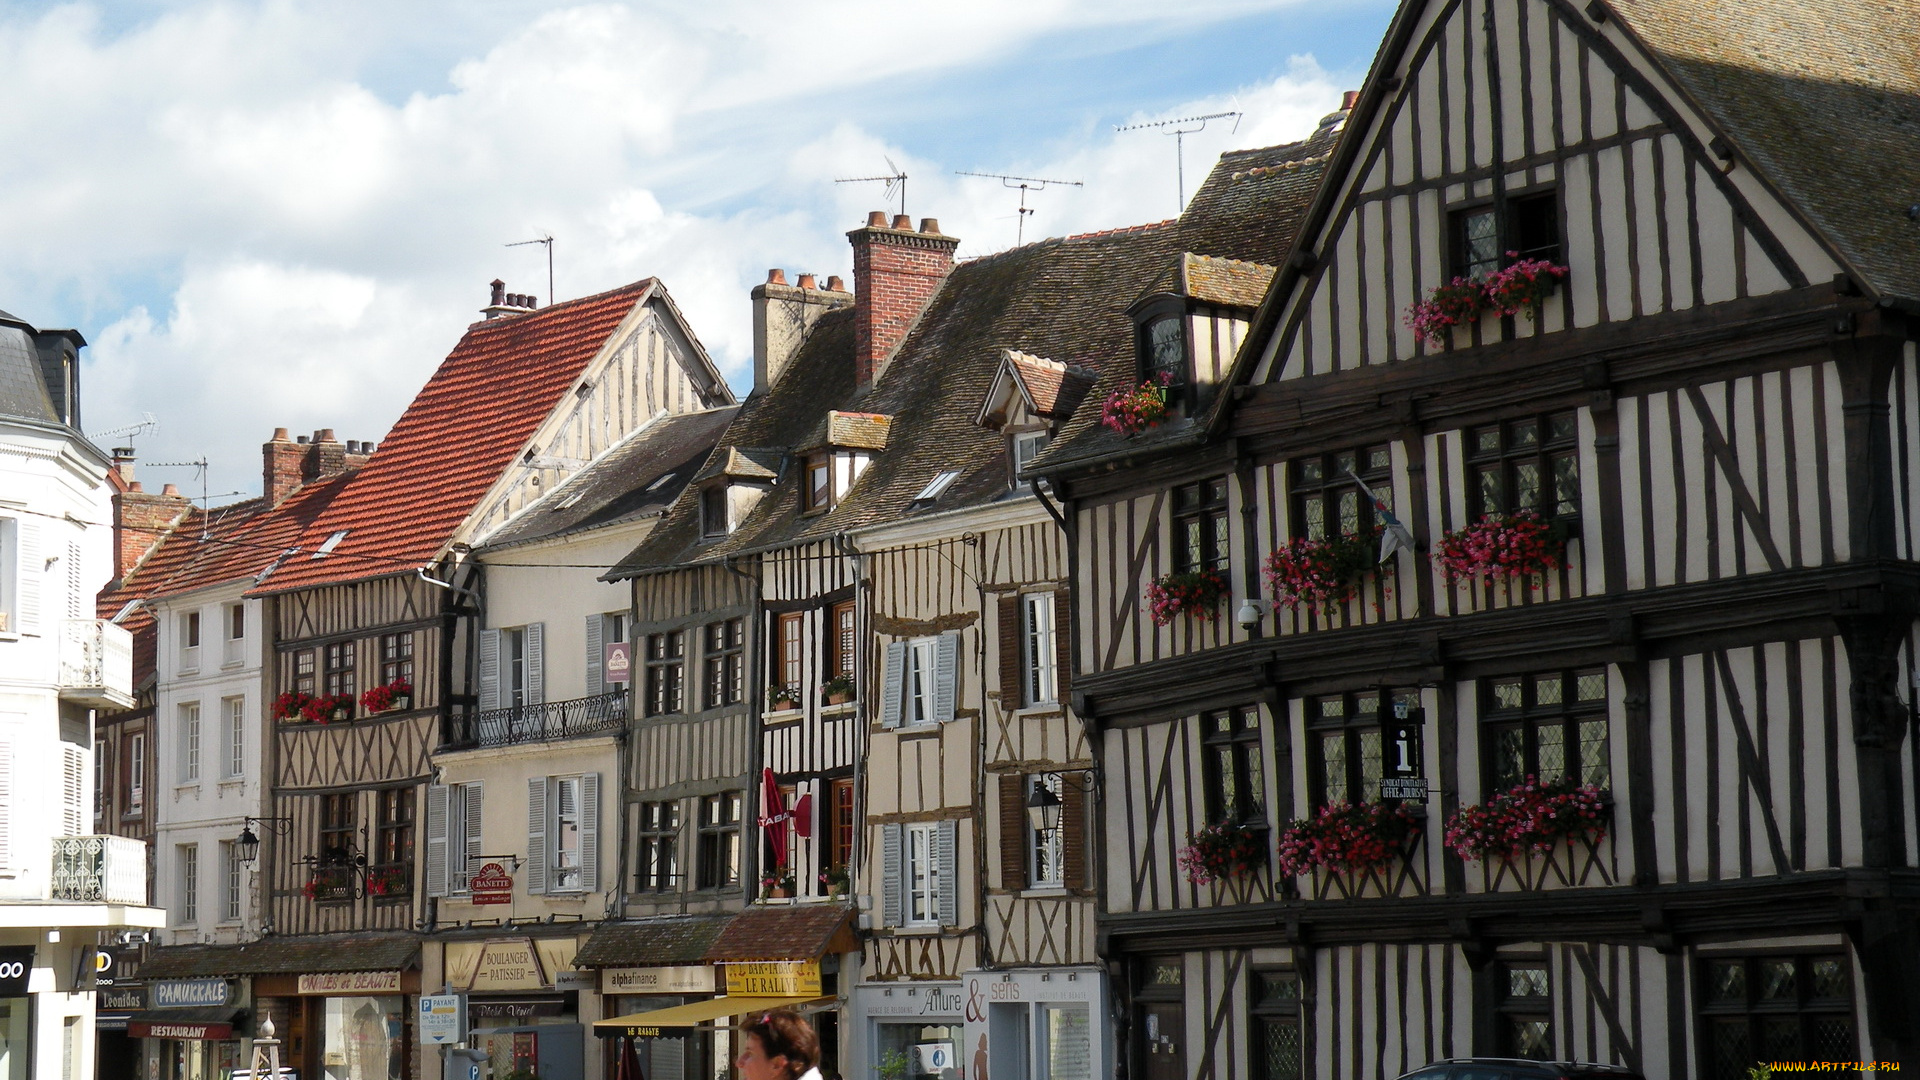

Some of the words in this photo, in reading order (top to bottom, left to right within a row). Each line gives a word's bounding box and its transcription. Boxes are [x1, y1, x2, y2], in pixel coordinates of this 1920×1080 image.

[1396, 730, 1412, 771] i
[1383, 788, 1399, 798] OFFICE
[1404, 788, 1427, 798] TOURISME
[486, 951, 529, 965] BOULANGER
[490, 968, 526, 981] PATISSIER
[612, 972, 657, 987] alphafinance
[301, 977, 338, 991] ONGLES
[341, 979, 351, 989] et
[745, 978, 758, 992] LE
[761, 977, 799, 992] RALLYE
[103, 991, 141, 1008] Leonidas
[159, 982, 225, 1003] PAMUKKALE
[966, 978, 987, 1022] &
[991, 982, 1020, 1000] sens
[151, 1025, 207, 1038] RESTAURANT
[627, 1027, 635, 1036] LE
[638, 1027, 660, 1036] RALLYE
